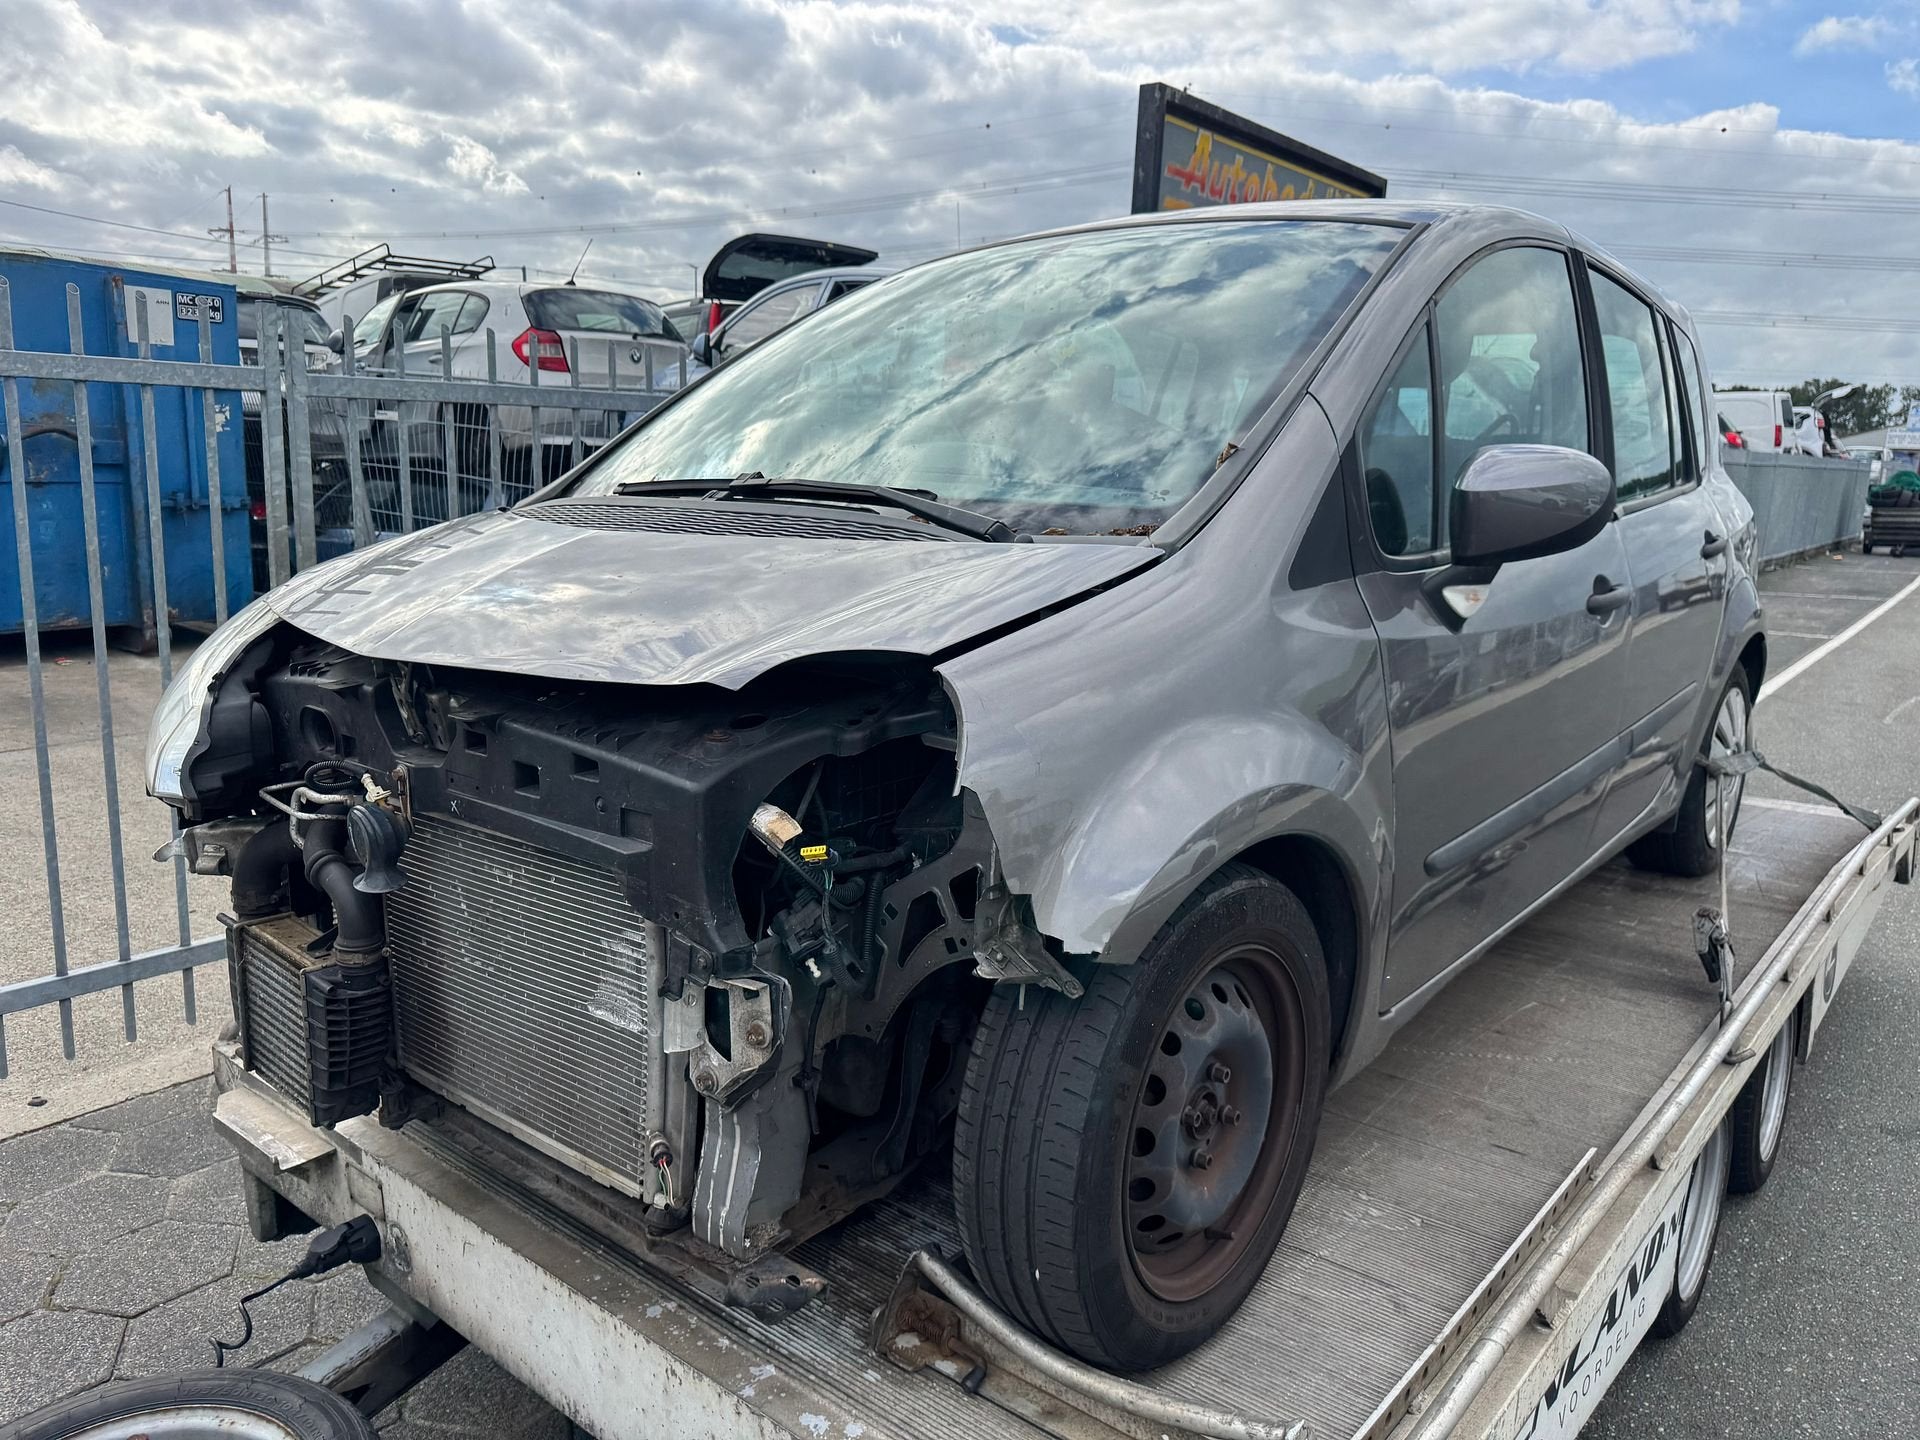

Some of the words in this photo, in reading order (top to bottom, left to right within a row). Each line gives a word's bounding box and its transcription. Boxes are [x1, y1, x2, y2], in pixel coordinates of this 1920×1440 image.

[178, 295, 193, 304] MC
[180, 306, 200, 317] 323
[209, 309, 220, 320] kg
[1558, 1296, 1647, 1429] VOORDELIG
